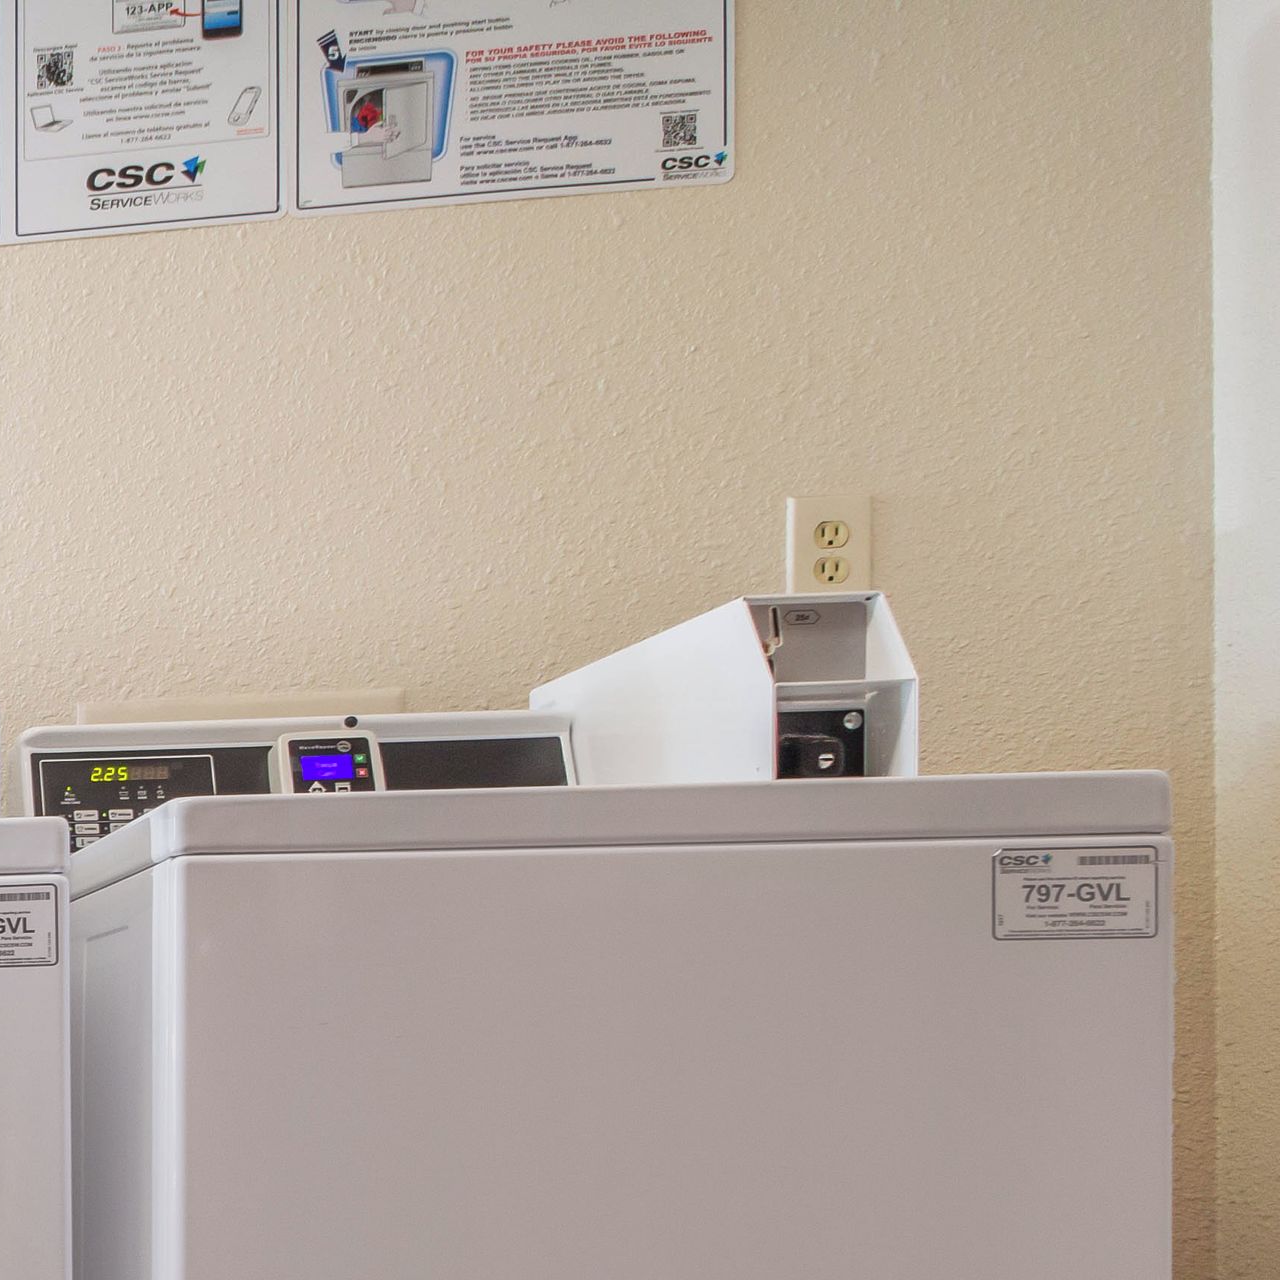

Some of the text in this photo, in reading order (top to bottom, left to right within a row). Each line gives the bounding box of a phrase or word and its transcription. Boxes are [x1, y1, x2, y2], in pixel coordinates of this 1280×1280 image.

[125, 2, 173, 17] 123-APP
[465, 29, 707, 58] FOR YOUR SAFETY PLEASE AVOID THE FOLLOWING
[498, 53, 528, 61] PROPIA
[581, 46, 598, 54] POR
[600, 44, 626, 52] FAVOR
[628, 42, 653, 50] EVITE
[654, 40, 666, 48] LO
[667, 36, 713, 46] SIGUIENTE
[327, 45, 340, 60] 5
[661, 155, 711, 171] CSC
[86, 162, 175, 192] CSC
[90, 767, 128, 782] 2.25
[998, 855, 1040, 866] CSC
[1022, 883, 1131, 903] 797-GVL
